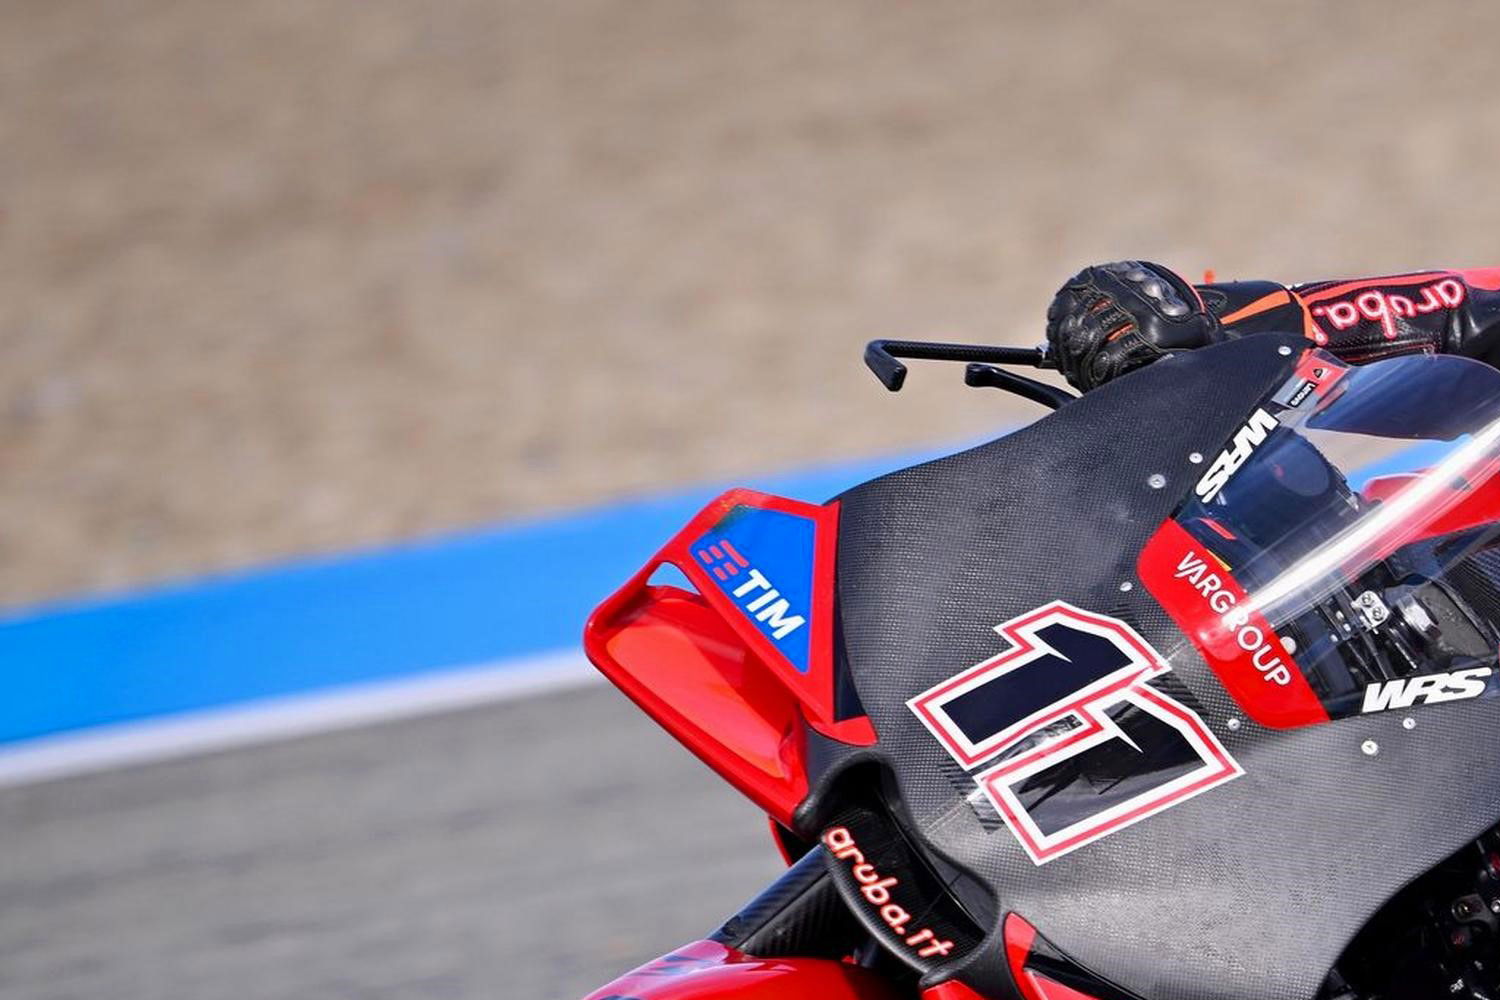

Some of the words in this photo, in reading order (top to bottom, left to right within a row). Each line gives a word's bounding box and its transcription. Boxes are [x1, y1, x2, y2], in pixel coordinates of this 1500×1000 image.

[1195, 408, 1281, 503] WRS
[730, 569, 806, 641] TIM
[1362, 667, 1493, 713] WRS
[824, 826, 956, 959] aruba.it
